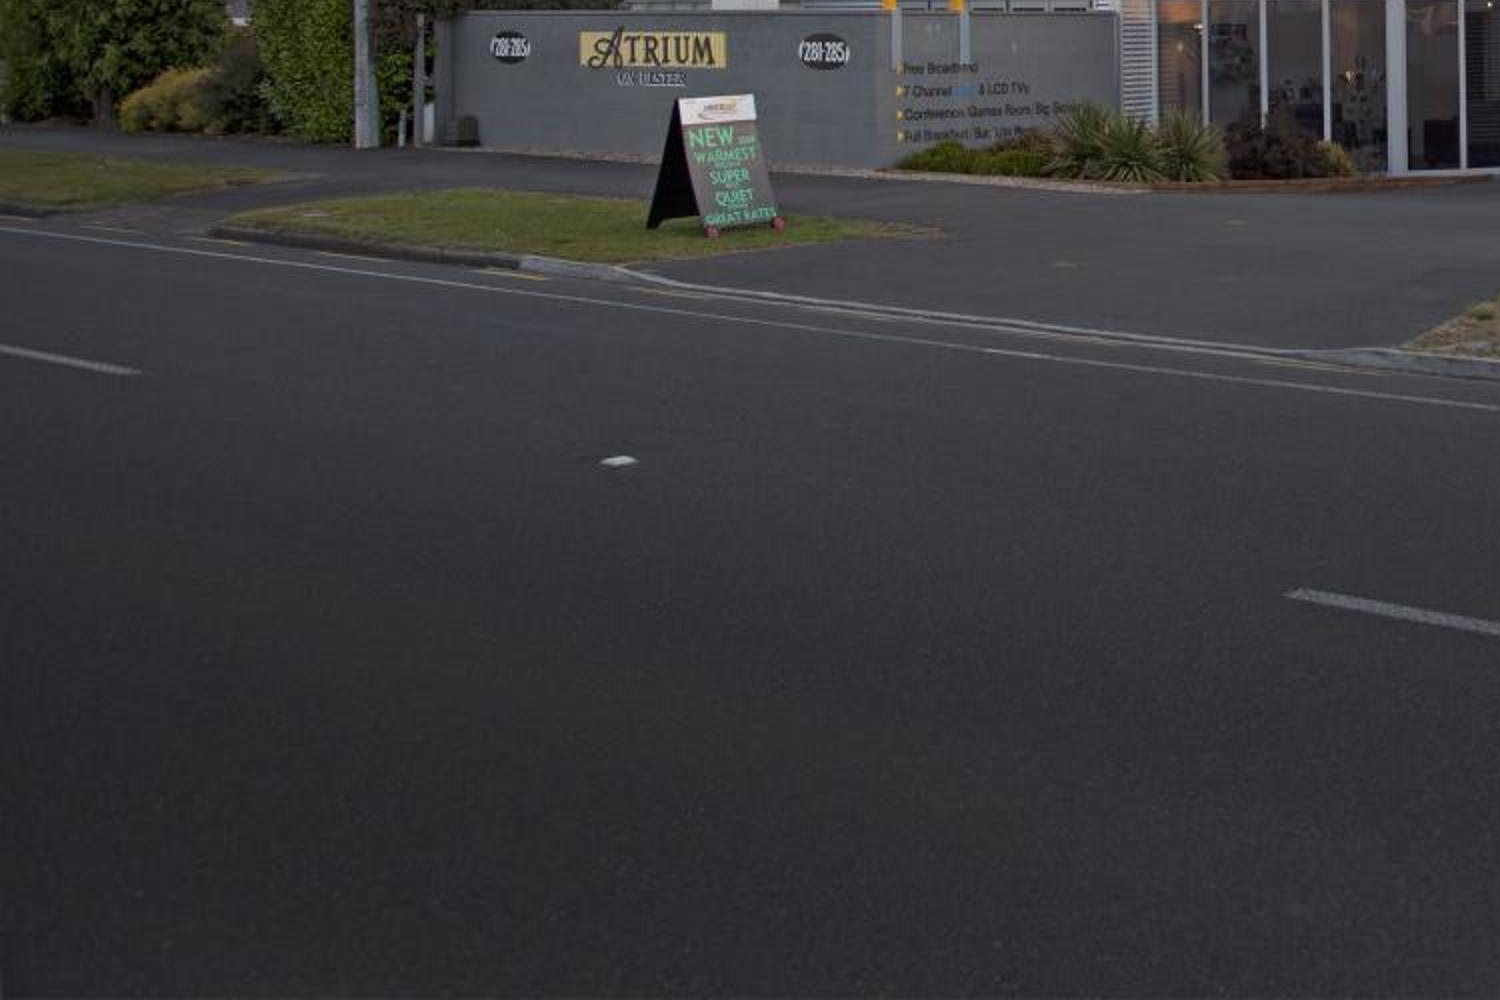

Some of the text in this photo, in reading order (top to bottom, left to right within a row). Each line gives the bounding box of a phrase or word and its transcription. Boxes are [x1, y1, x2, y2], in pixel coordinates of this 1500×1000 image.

[587, 26, 714, 69] ATRIUM
[688, 125, 734, 148] NEW
[693, 146, 755, 166] WARMEST
[708, 167, 751, 186] SUPER
[714, 188, 754, 208] QUIET
